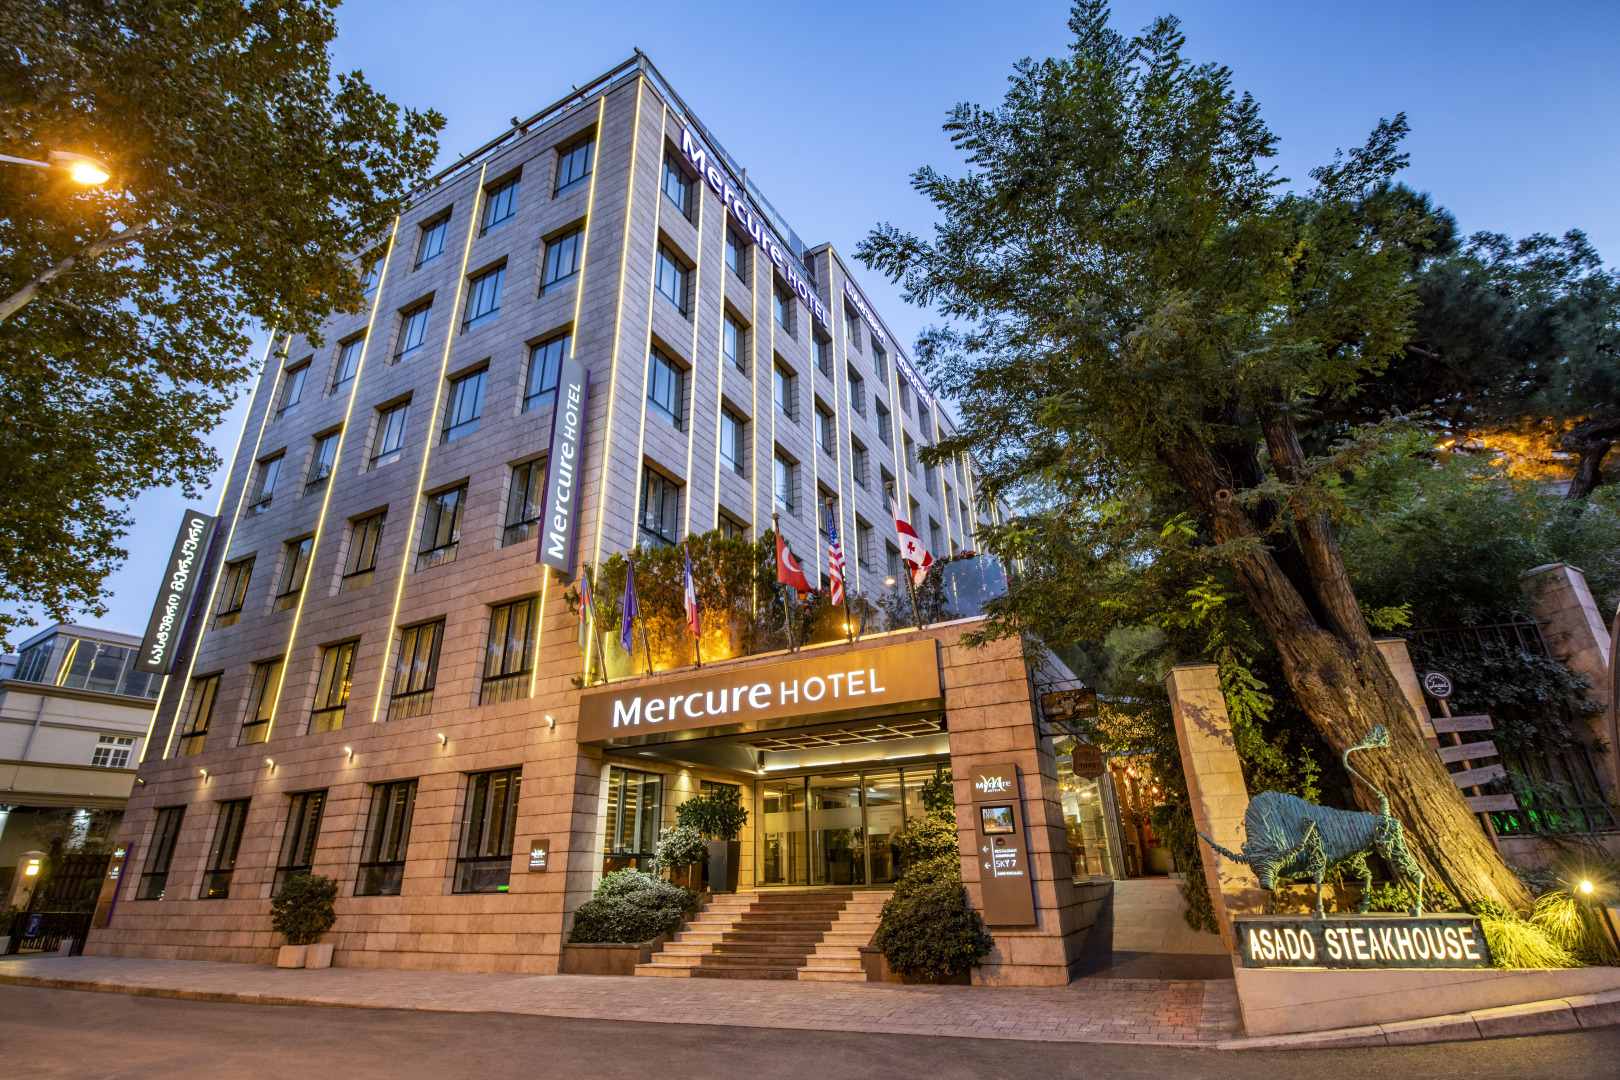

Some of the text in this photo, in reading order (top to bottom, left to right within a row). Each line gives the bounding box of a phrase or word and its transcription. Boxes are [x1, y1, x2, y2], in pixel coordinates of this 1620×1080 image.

[681, 128, 829, 328] Mercure HOTEL
[548, 383, 581, 560] Mercure HOTEL
[148, 518, 205, 665] სასტუმრო მერკური
[612, 668, 885, 728] Mercure HOTEL
[995, 859, 1017, 868] SKY 7
[29, 918, 38, 933] P
[1249, 927, 1481, 960] ASADO STEAKHOUSE
